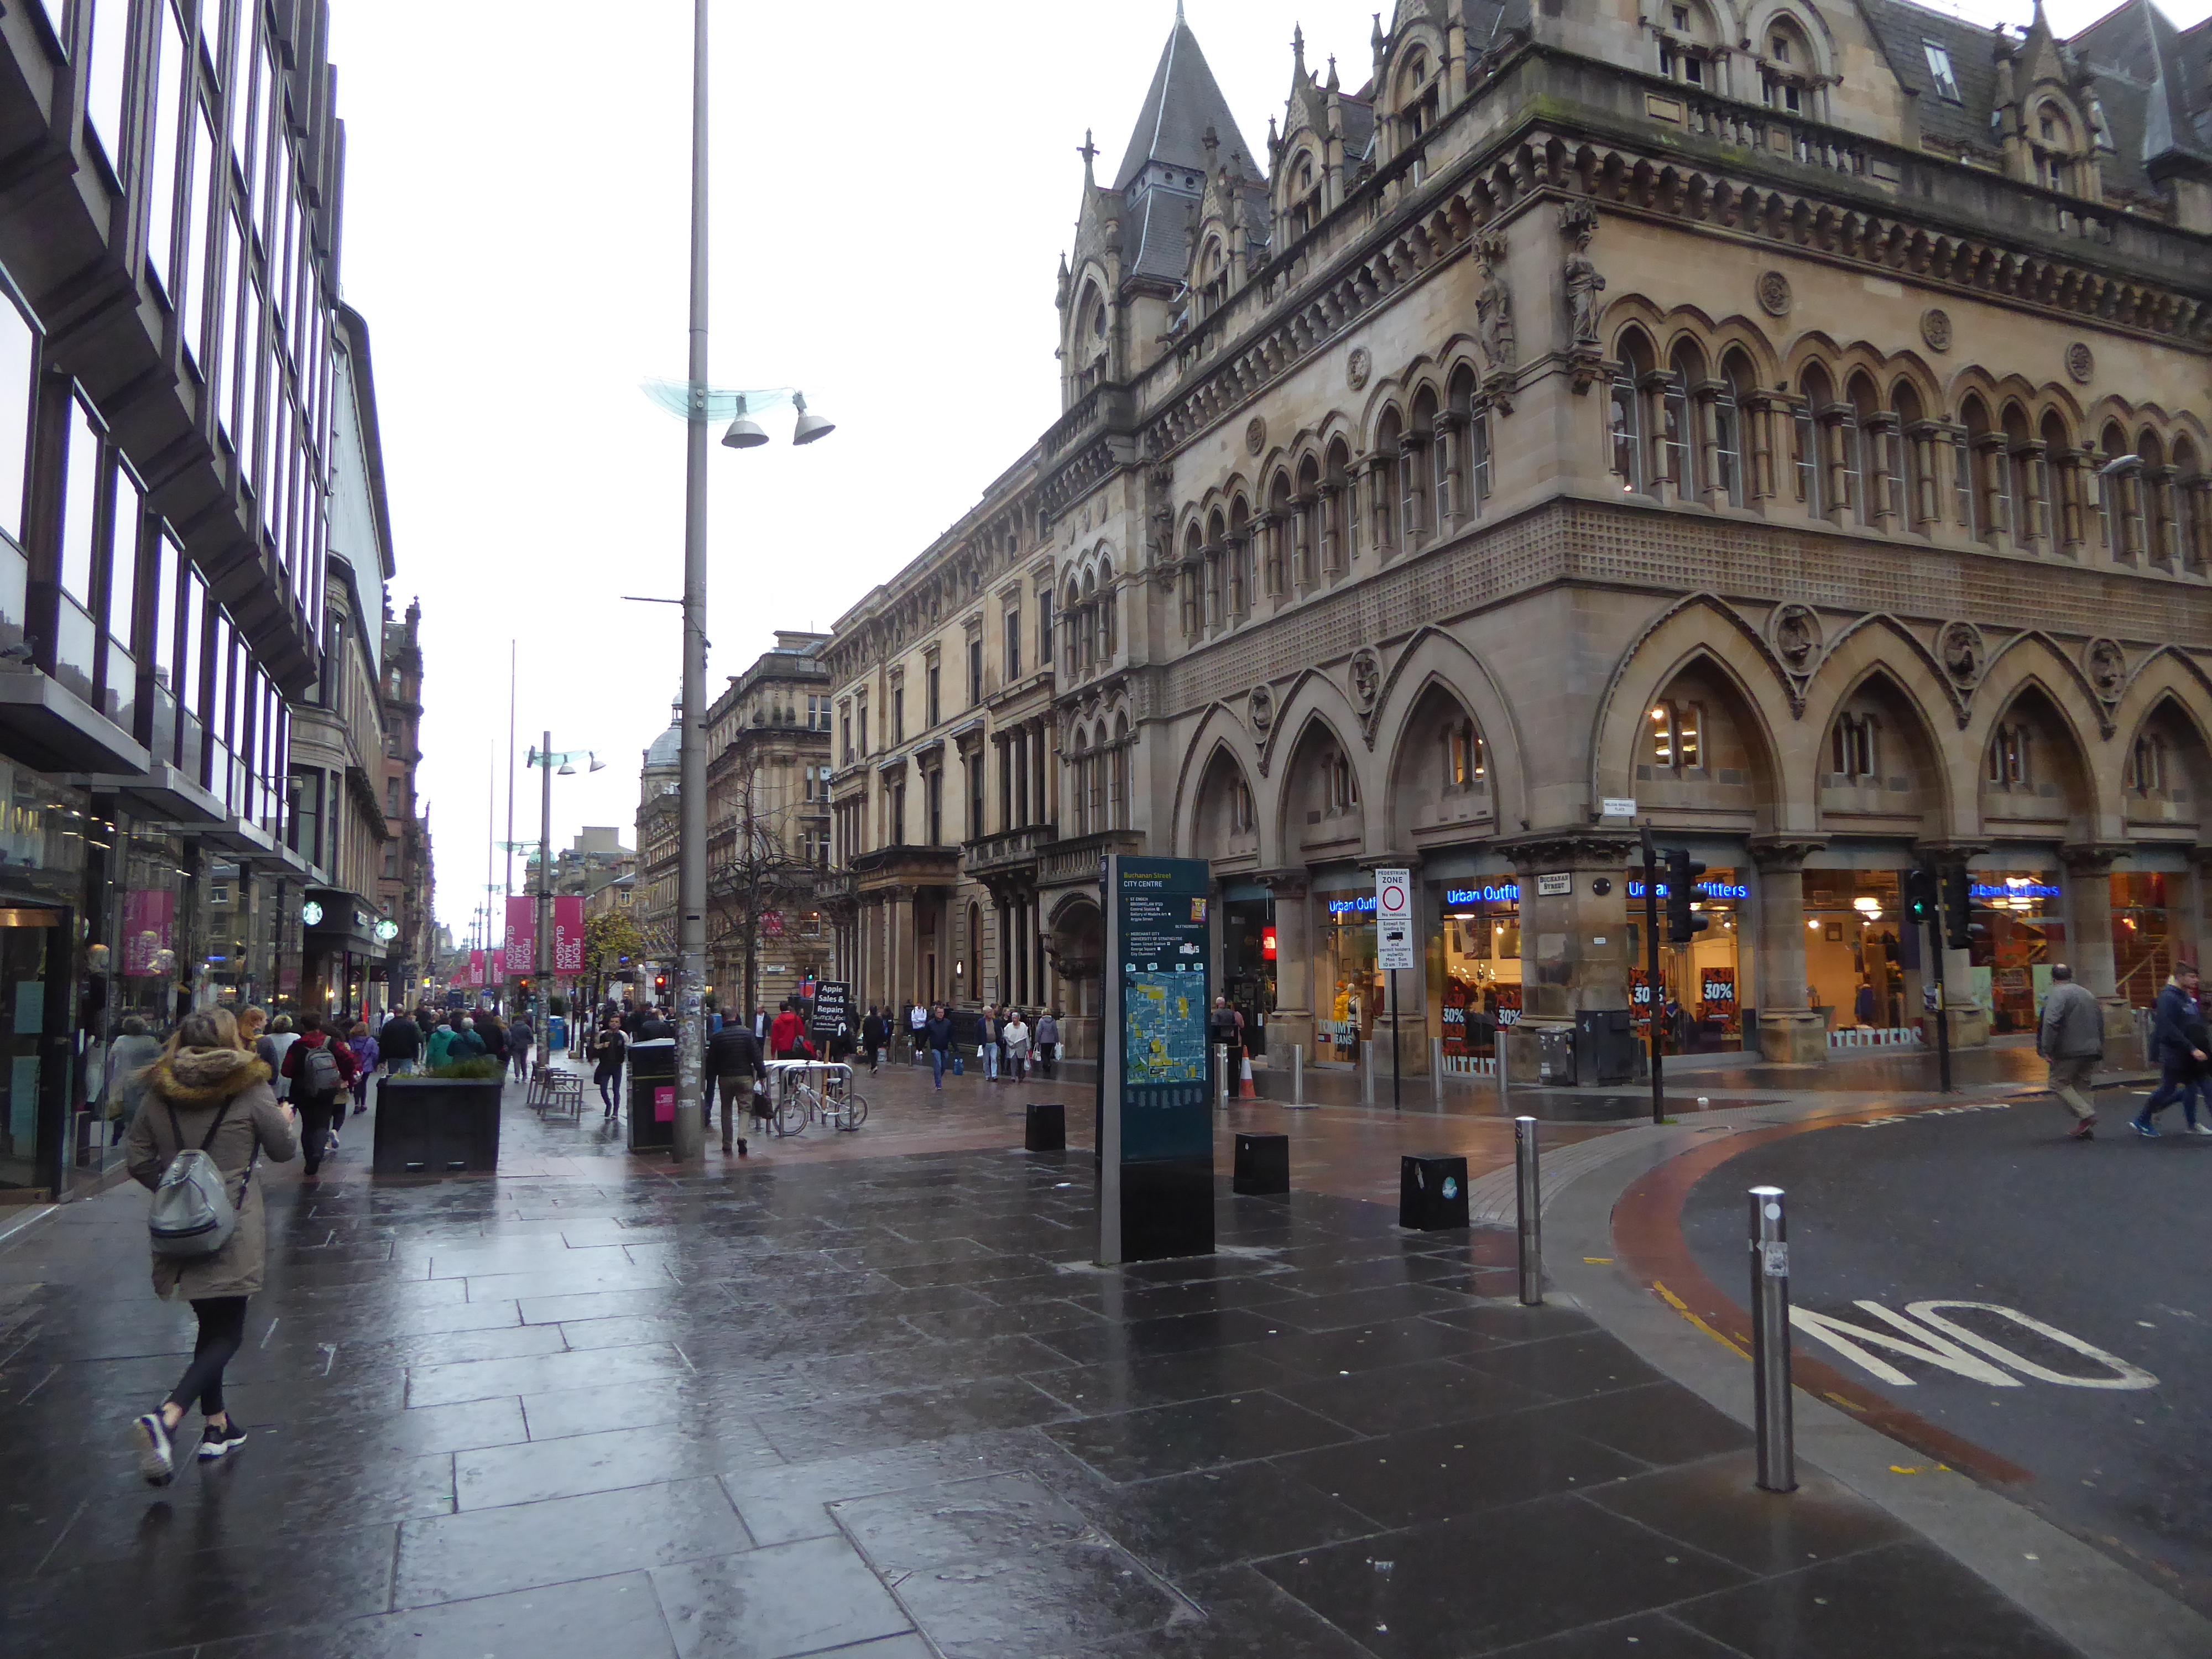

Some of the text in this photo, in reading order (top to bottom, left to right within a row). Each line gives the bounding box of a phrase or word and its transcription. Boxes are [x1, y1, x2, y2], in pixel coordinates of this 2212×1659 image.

[1447, 889, 1480, 904] Urban
[1329, 899, 1354, 912] Urban
[506, 925, 515, 969] GLASGOW
[523, 938, 531, 969] PEOPLE
[556, 925, 565, 969] GLASGOW
[572, 938, 581, 969] PEOPLE
[822, 985, 843, 993] Apple
[1704, 983, 1732, 1000] 30%
[817, 1005, 844, 1014] Repairs
[1443, 1008, 1464, 1022] 30%
[1498, 1009, 1521, 1025] 30%
[1318, 1019, 1352, 1034] TOMMY
[1788, 1300, 2160, 1390] NO
